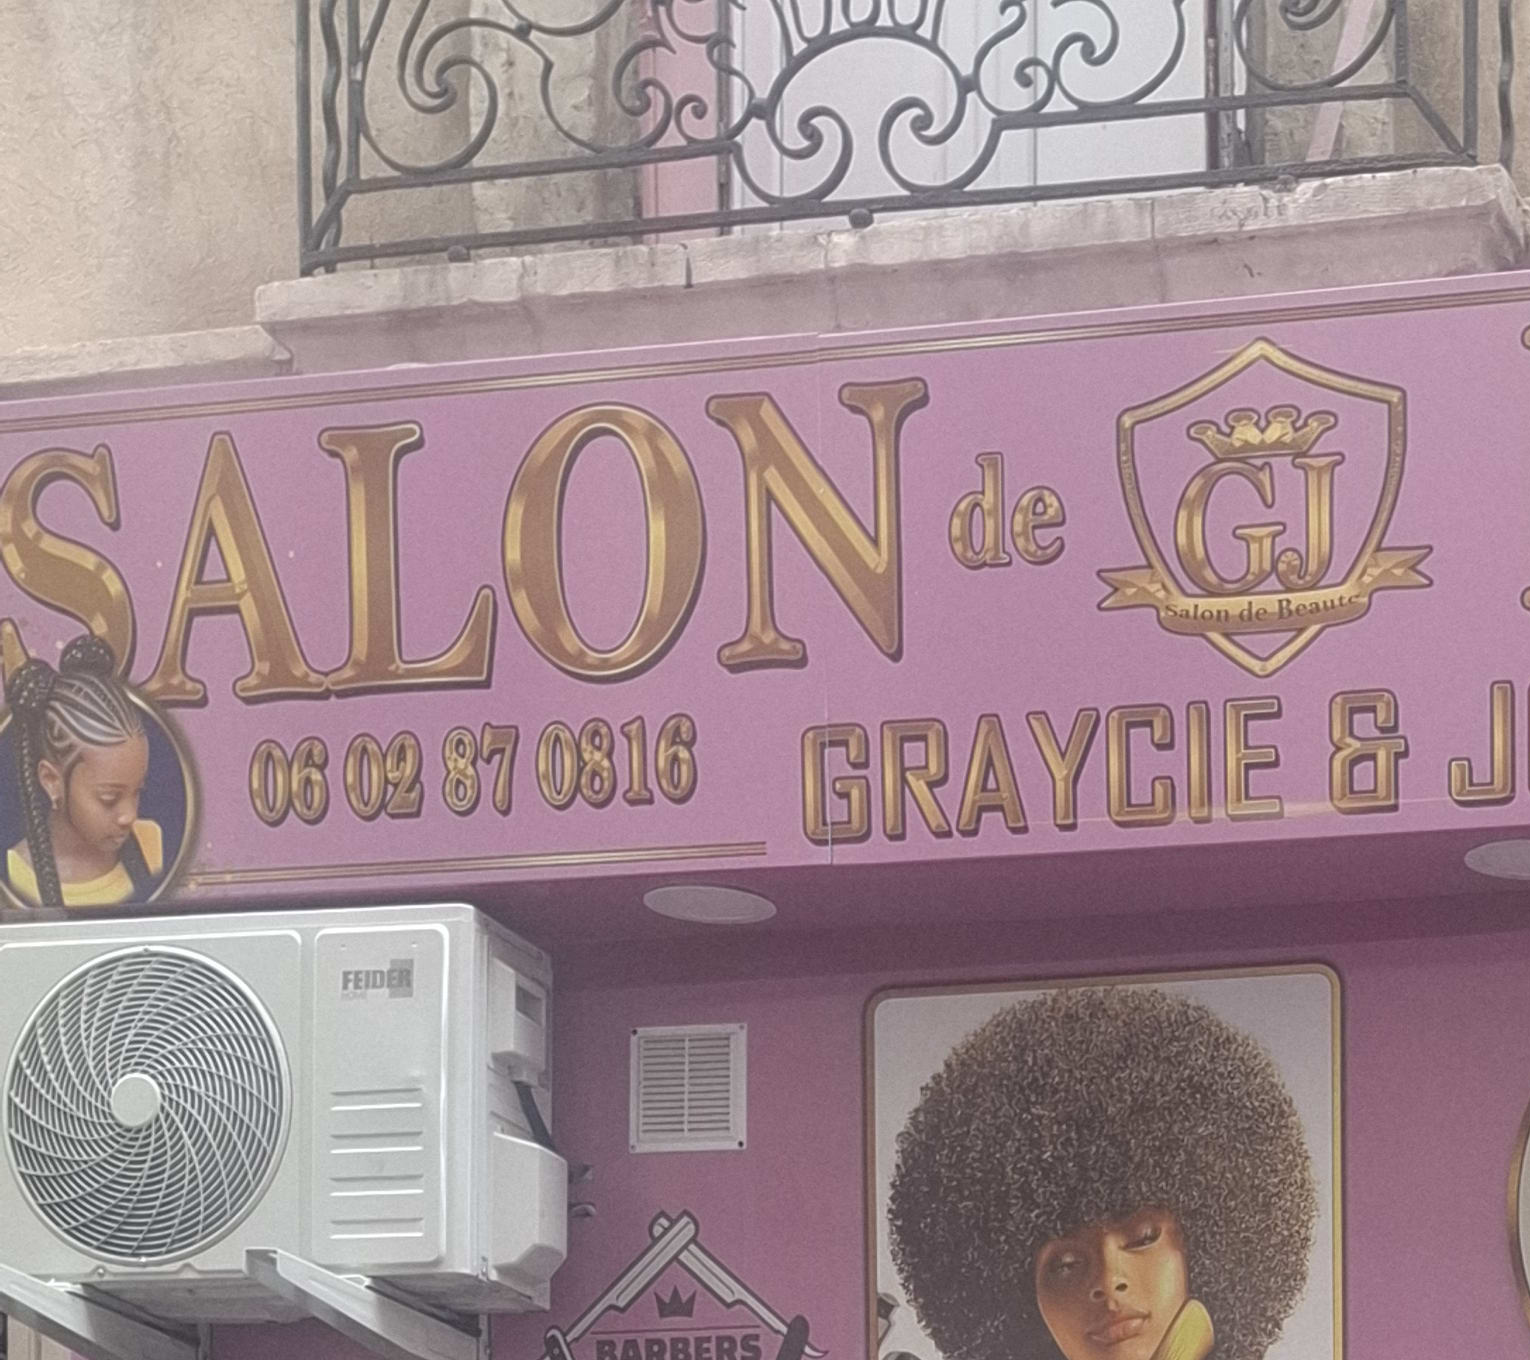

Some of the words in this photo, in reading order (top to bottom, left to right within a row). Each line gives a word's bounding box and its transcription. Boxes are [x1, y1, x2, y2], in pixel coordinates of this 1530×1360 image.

[0, 378, 930, 706] SALON
[948, 451, 1066, 569] de
[1173, 451, 1345, 594] GJ
[1164, 604, 1229, 622] Salon
[1237, 600, 1269, 623] de
[248, 737, 330, 827] 06
[343, 730, 424, 821] 02
[441, 721, 520, 816] 87
[800, 695, 1285, 846] GRAYCIE
[1327, 687, 1408, 815] &
[341, 969, 412, 991] FEIDER
